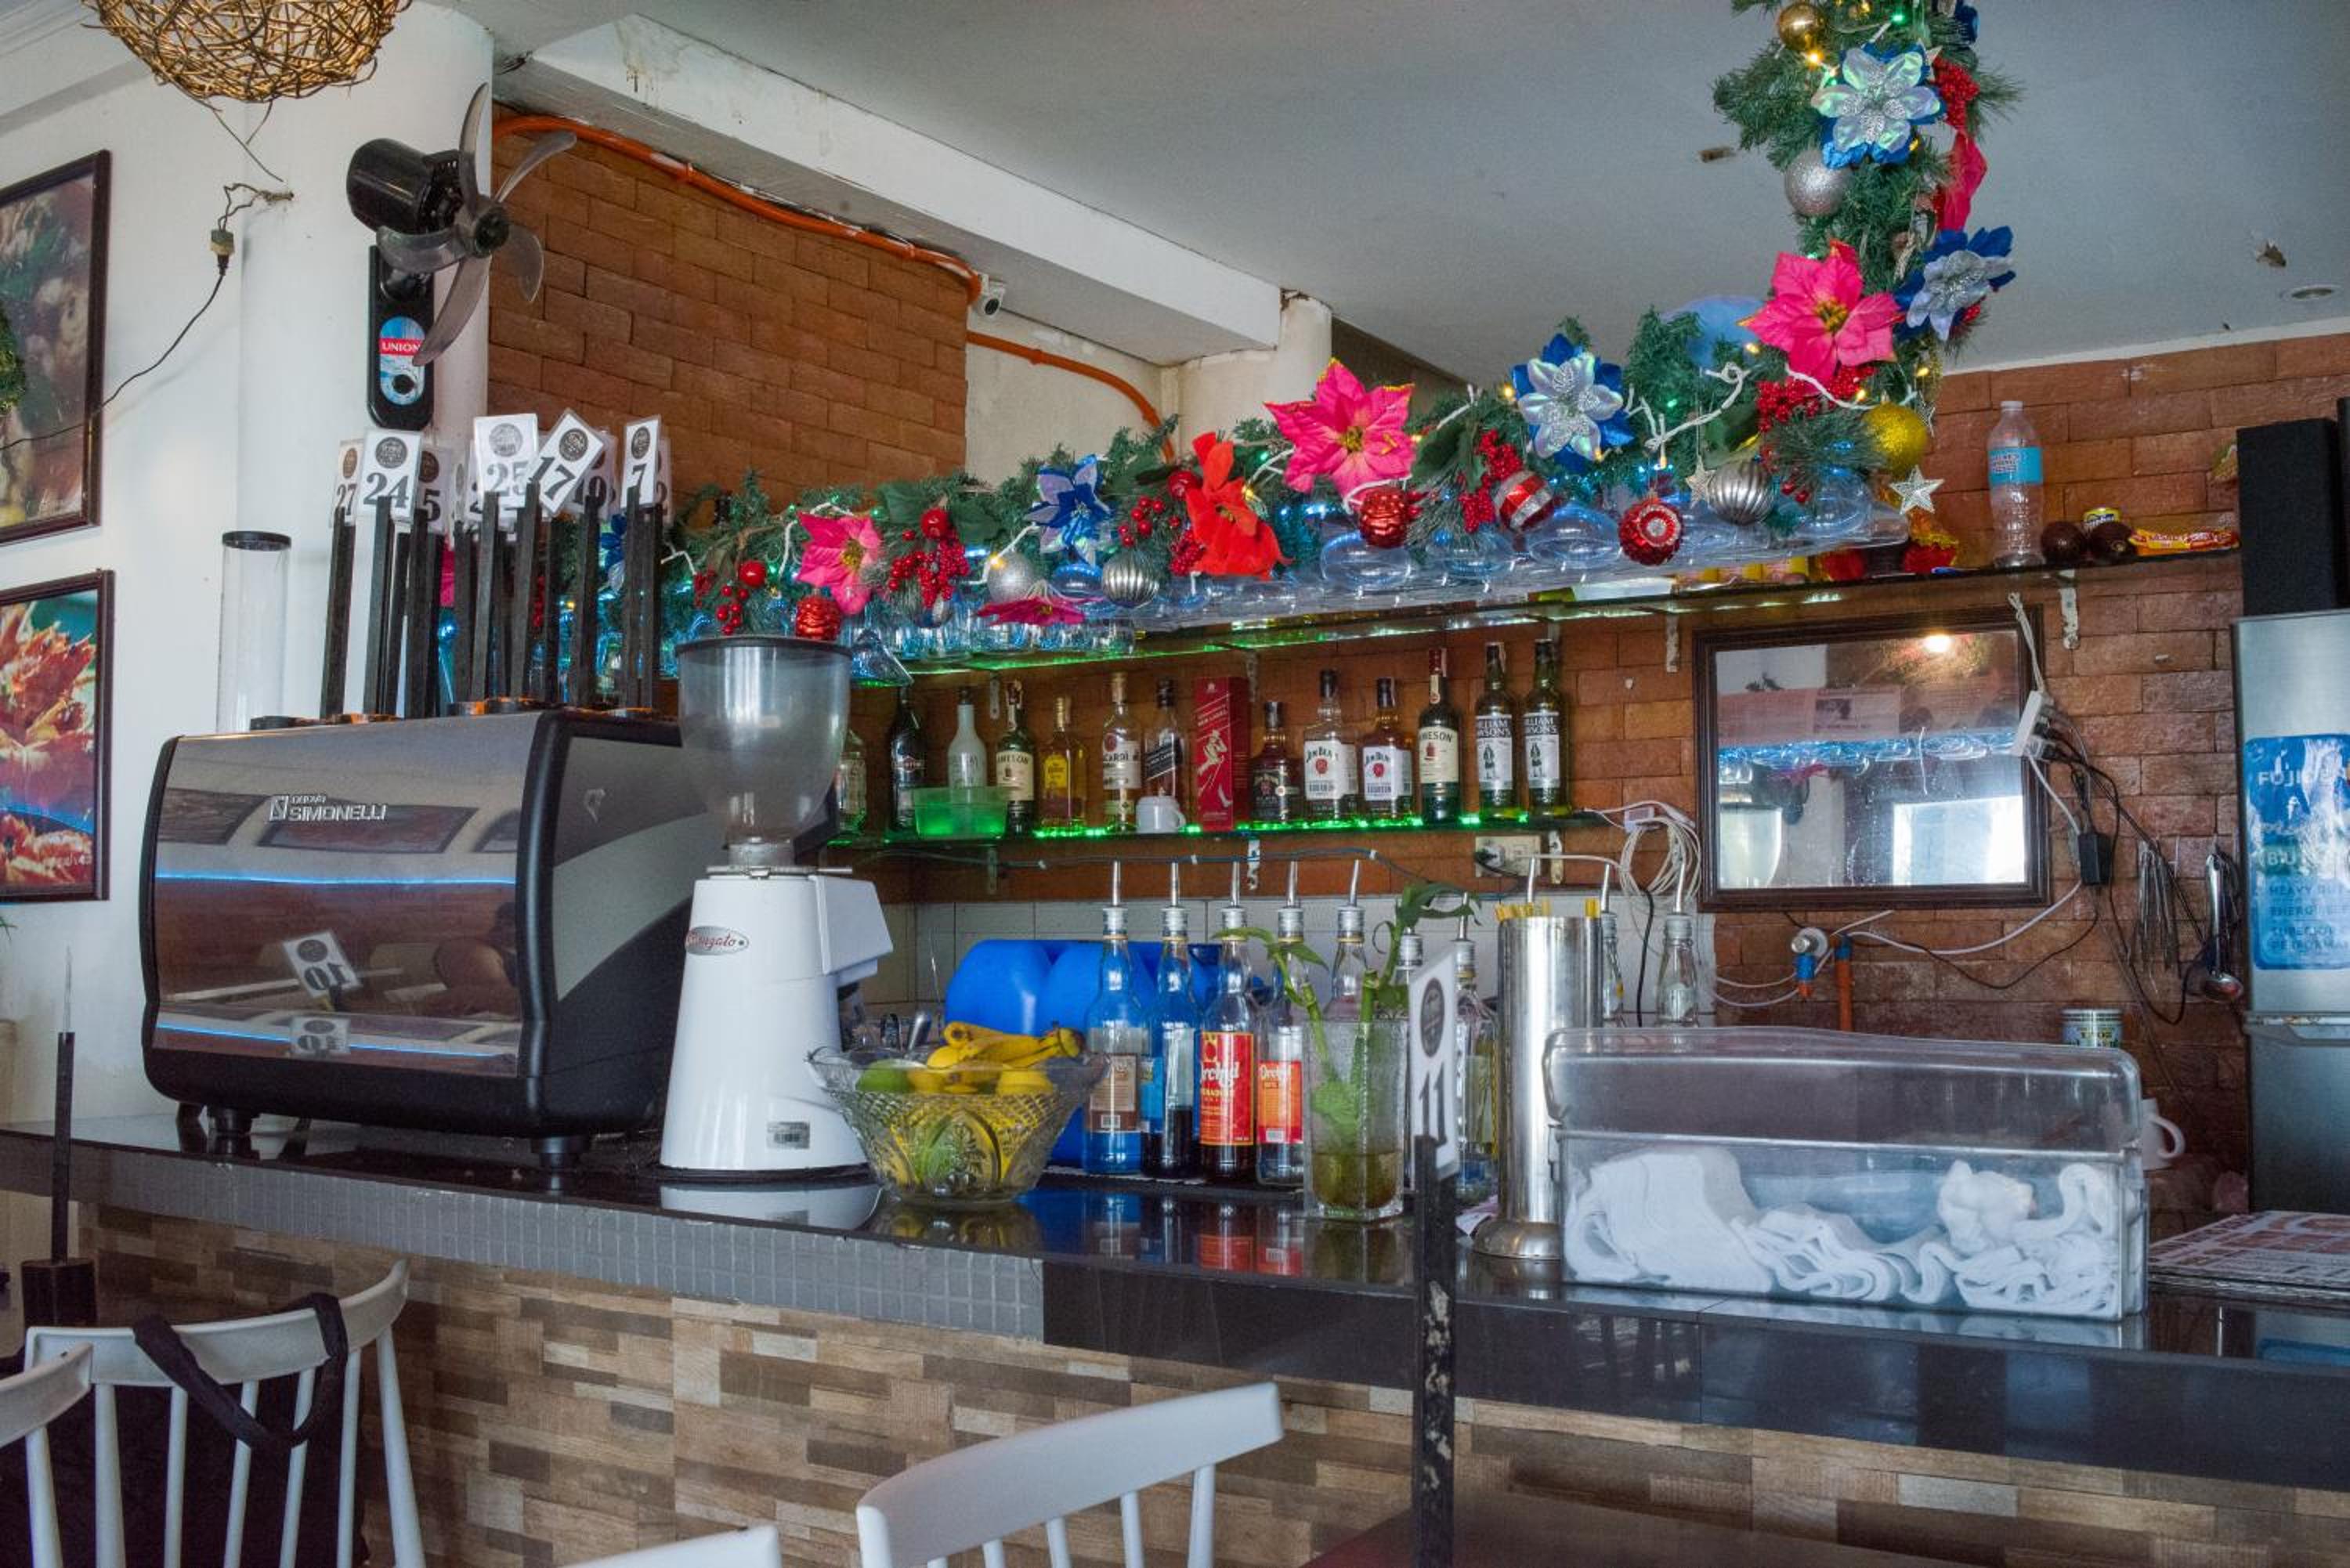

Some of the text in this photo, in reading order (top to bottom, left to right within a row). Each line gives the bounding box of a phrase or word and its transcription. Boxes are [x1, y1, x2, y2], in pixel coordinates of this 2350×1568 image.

[381, 341, 422, 352] UNION
[336, 483, 357, 516] 27
[363, 472, 410, 508] 24
[287, 804, 389, 822] SIMONELLI
[1419, 1062, 1448, 1148] 11
